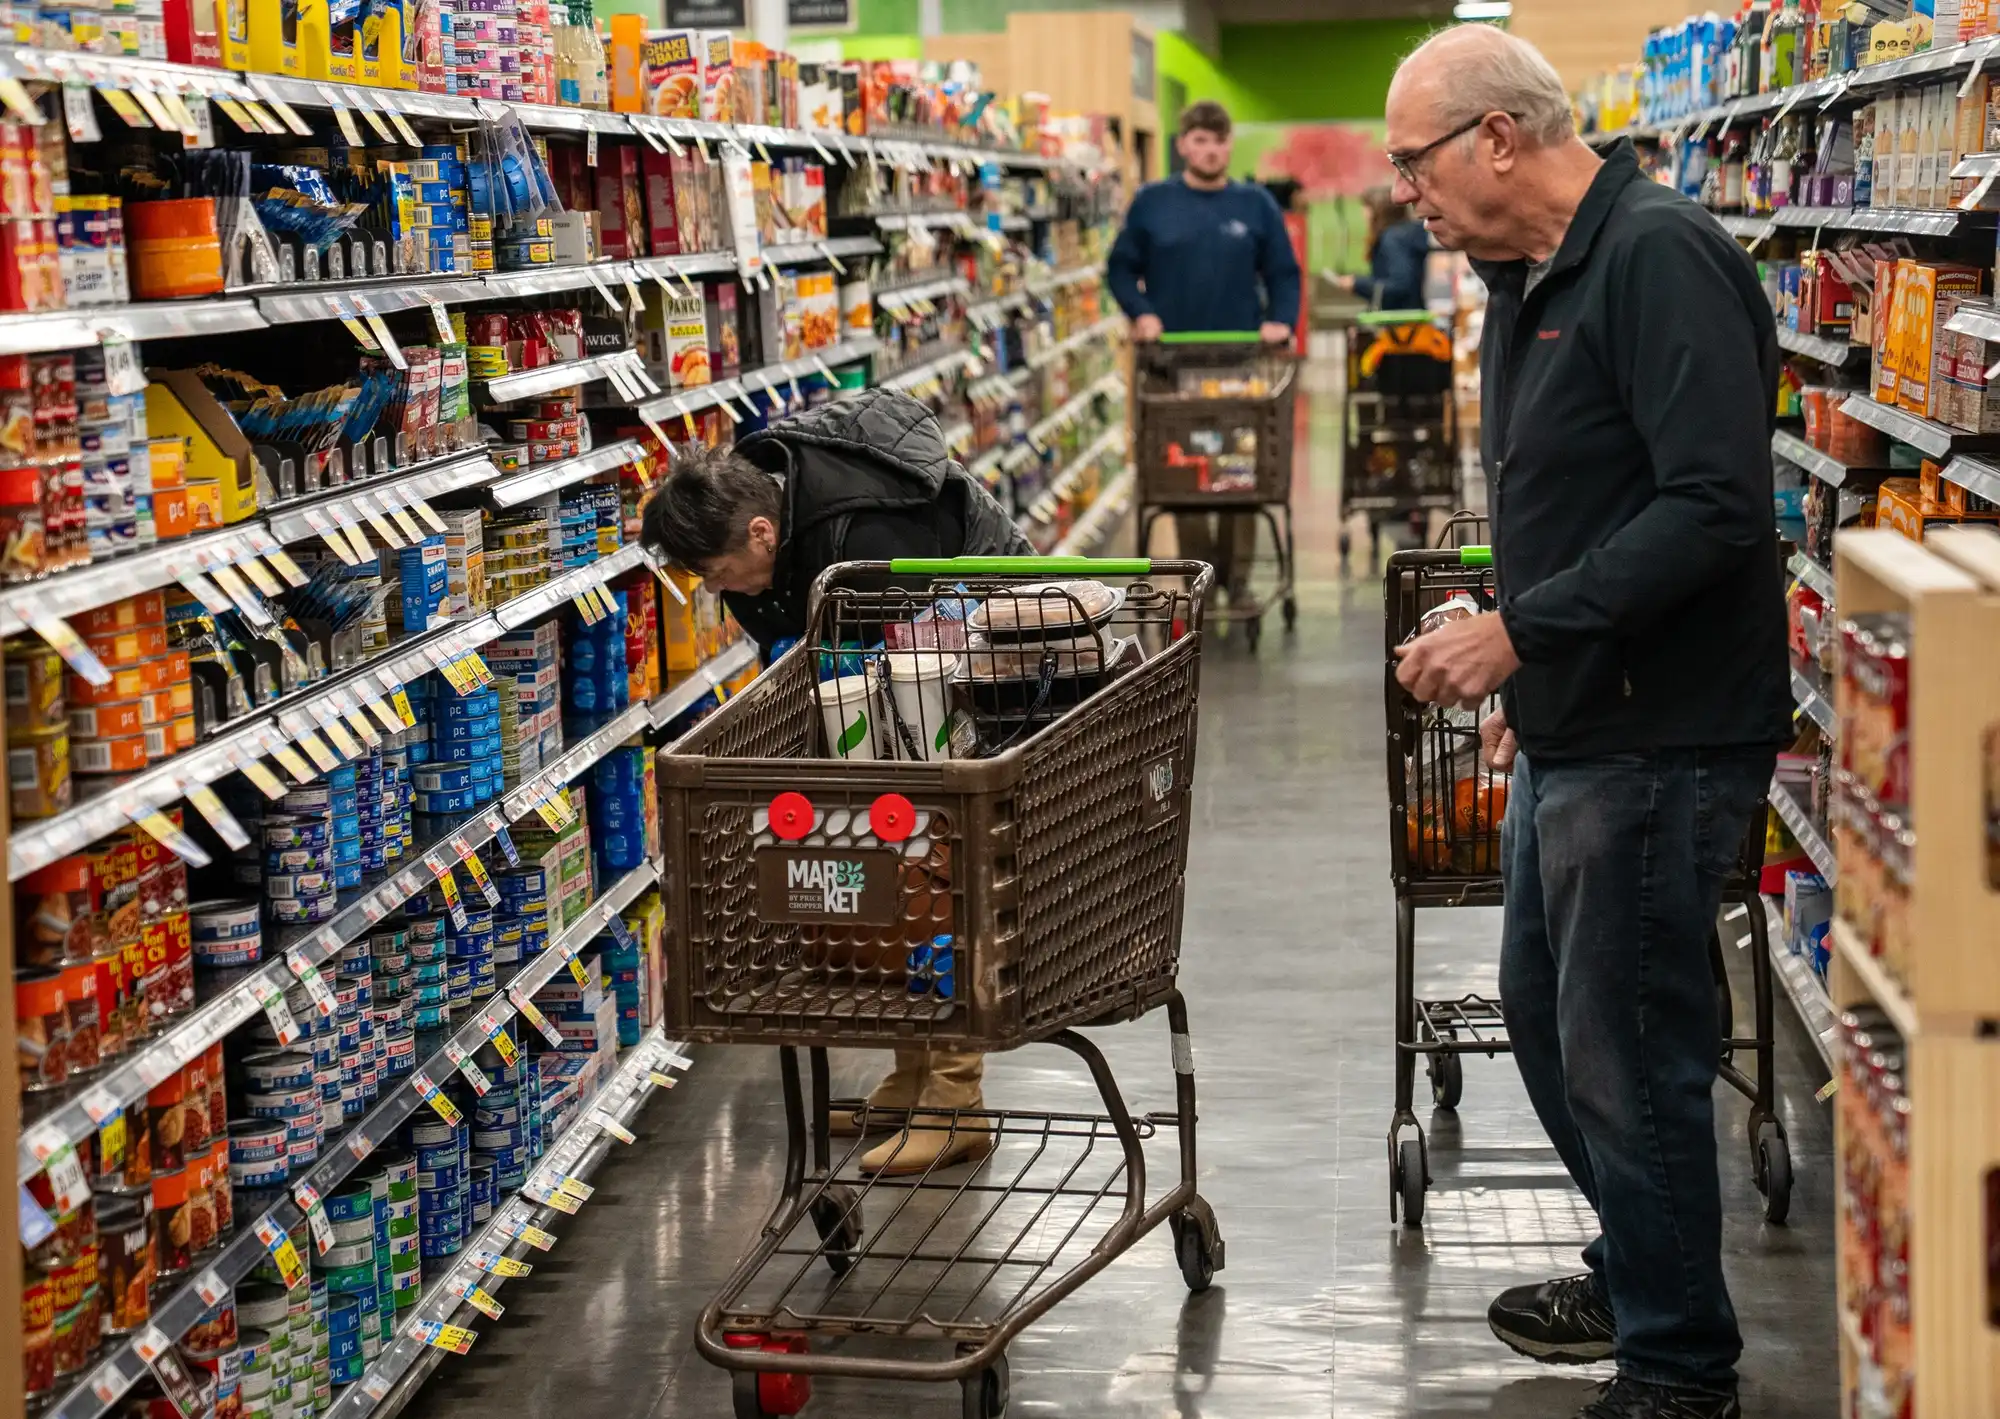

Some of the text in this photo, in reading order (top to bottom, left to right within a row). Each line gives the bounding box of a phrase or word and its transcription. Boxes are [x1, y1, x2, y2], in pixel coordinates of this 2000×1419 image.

[656, 50, 689, 65] BAKE
[456, 218, 466, 229] pc
[668, 299, 701, 316] PANKO
[169, 502, 185, 522] pc
[427, 561, 445, 577] SNACK
[491, 662, 522, 670] ALBACORE
[449, 707, 461, 716] pc
[453, 727, 465, 738] pc
[453, 748, 465, 758] pc
[461, 775, 469, 785] pc
[448, 798, 460, 809] pc
[788, 902, 823, 910] CHOPPER
[823, 887, 862, 913] KET
[333, 1204, 346, 1216] pc
[363, 1296, 373, 1311] pc
[348, 1312, 358, 1328] pc
[342, 1340, 353, 1355] pc
